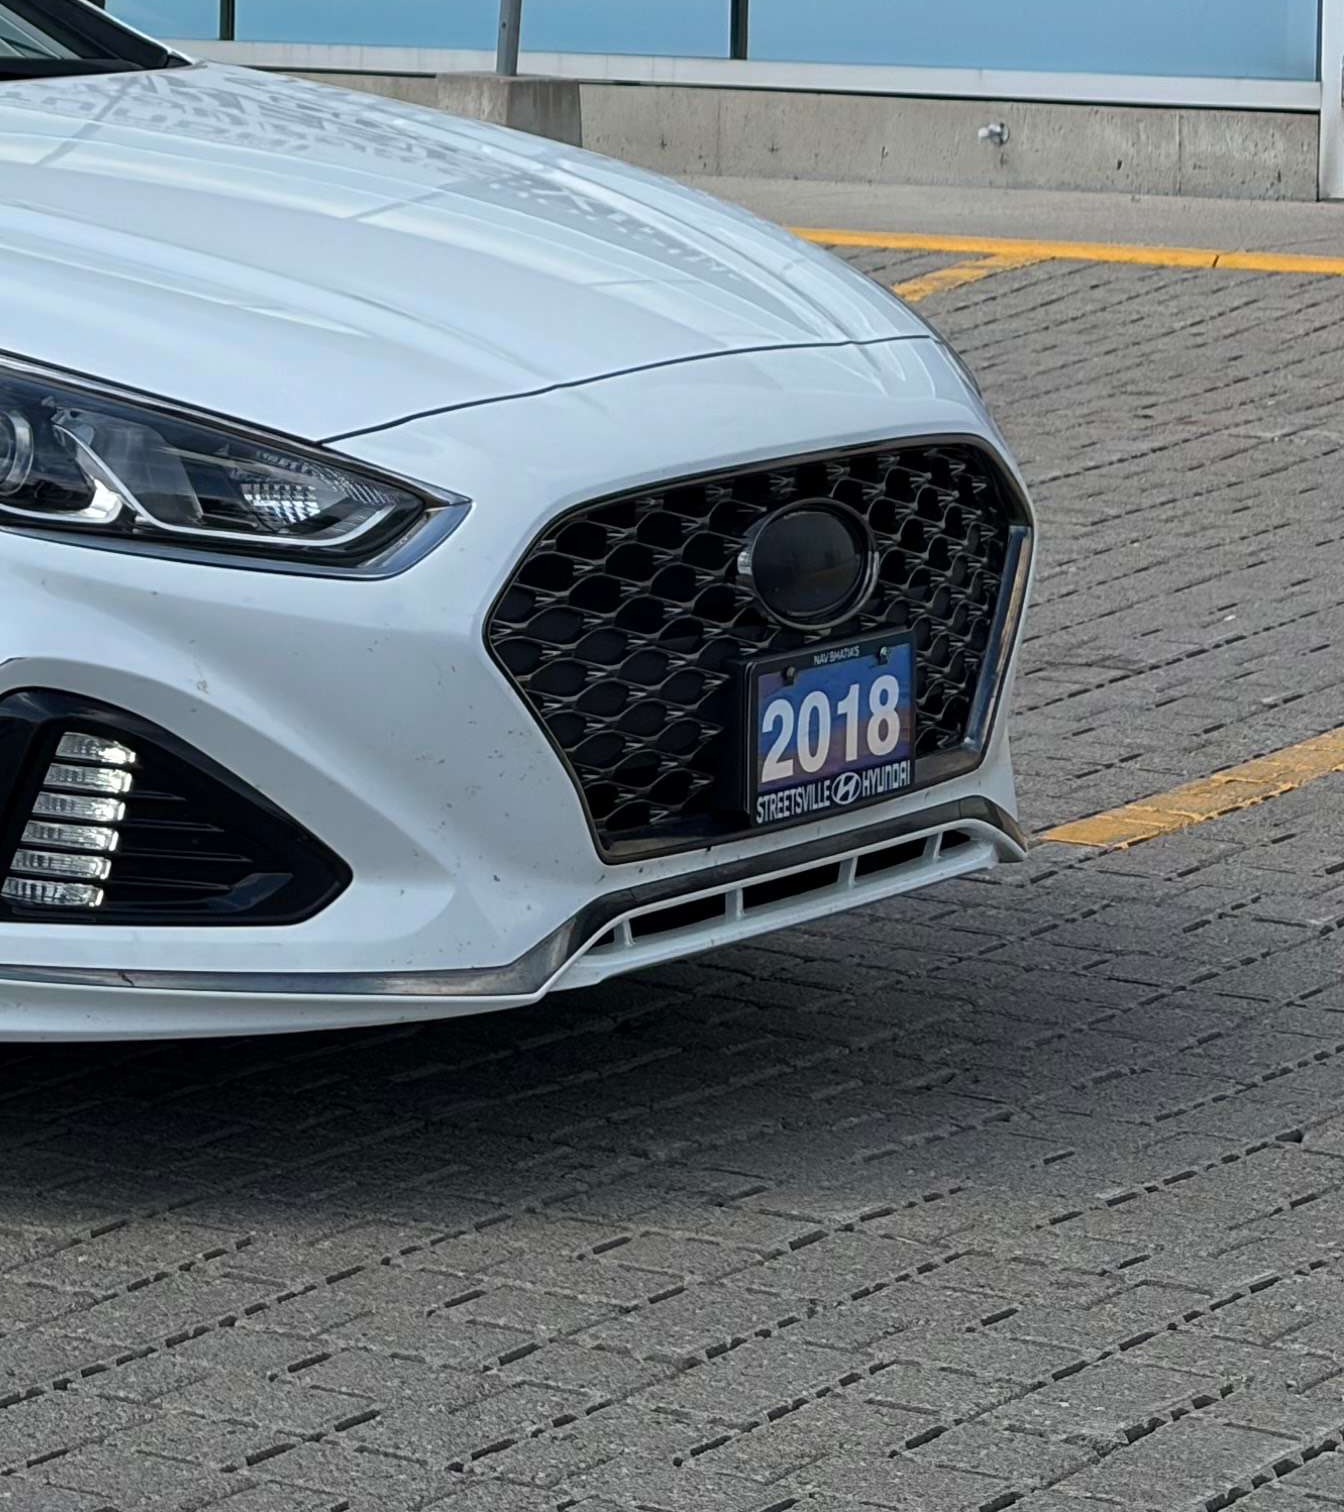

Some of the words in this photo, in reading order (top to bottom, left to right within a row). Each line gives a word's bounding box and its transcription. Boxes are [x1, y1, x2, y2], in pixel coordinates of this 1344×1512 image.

[761, 674, 900, 783] 2018
[755, 779, 831, 824] STREETSVILLE
[862, 759, 911, 798] HYUNDAI
